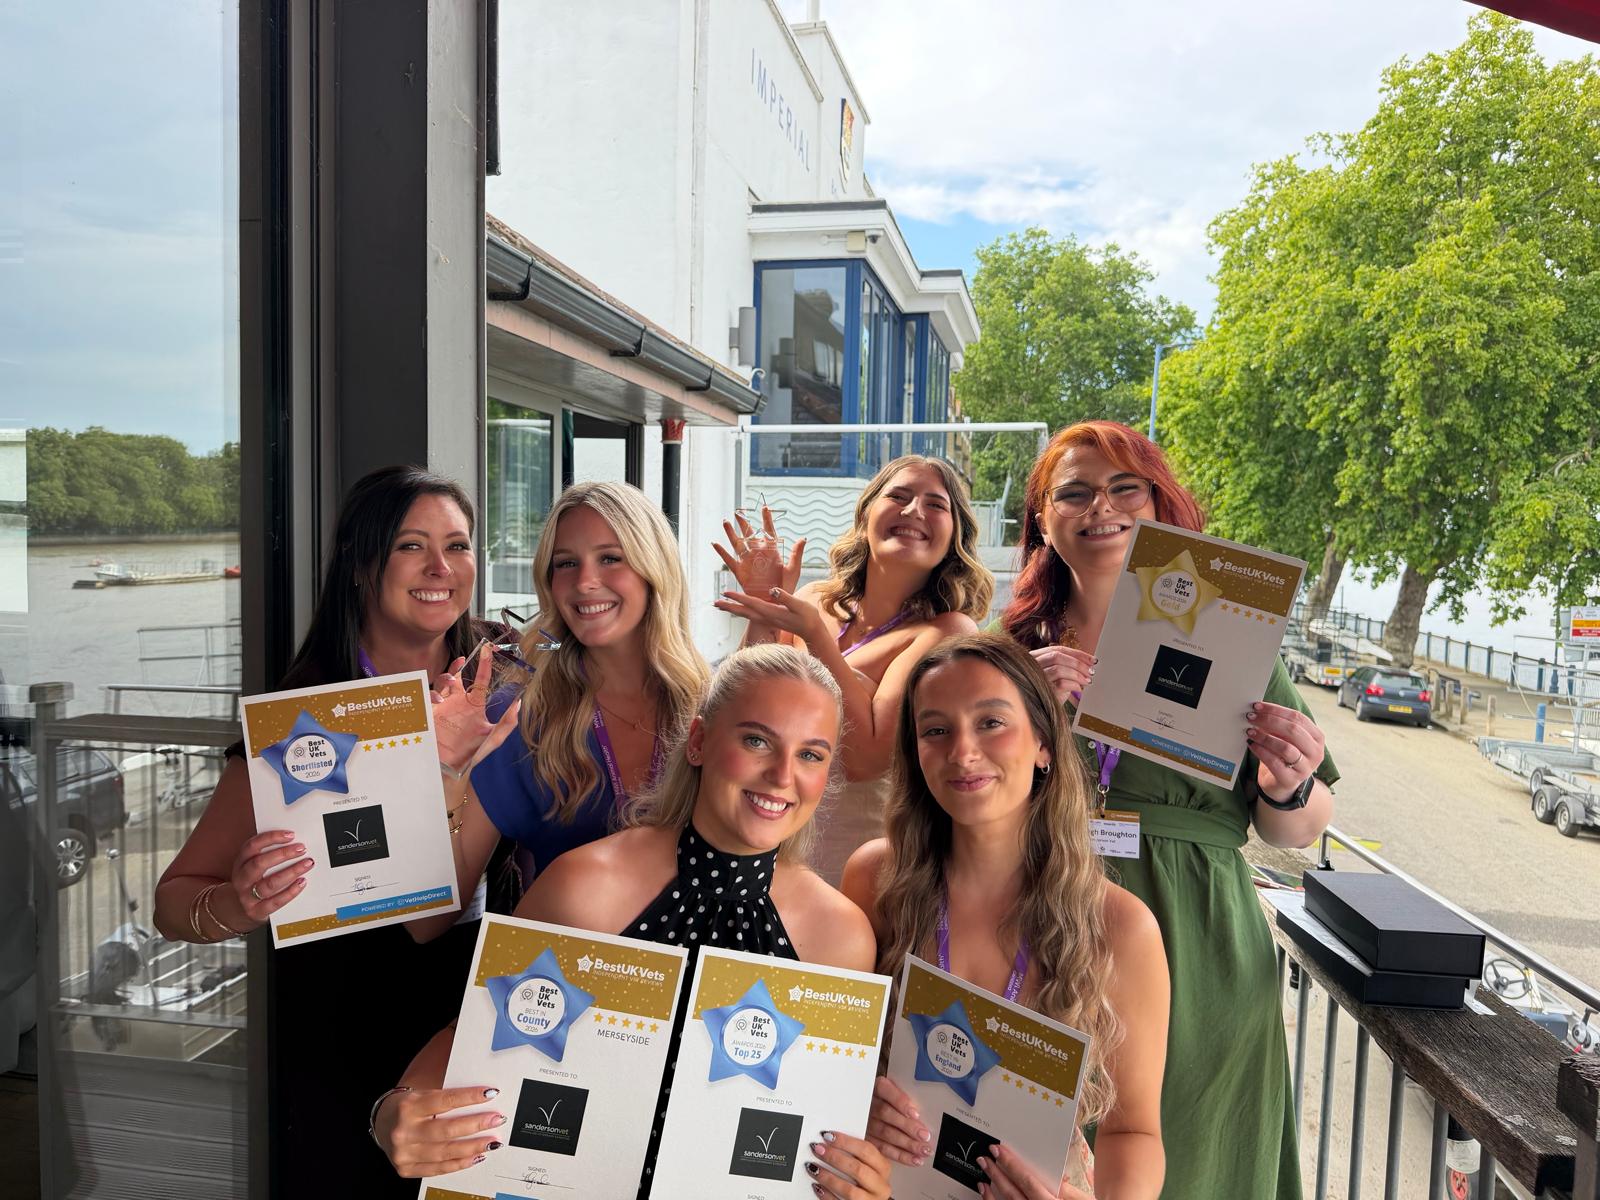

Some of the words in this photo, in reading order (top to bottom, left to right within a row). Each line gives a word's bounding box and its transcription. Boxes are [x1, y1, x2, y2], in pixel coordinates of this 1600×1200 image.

[751, 47, 810, 172] IMPERIAL
[1223, 561, 1286, 585] BestUKVets
[1177, 578, 1193, 586] Best
[1175, 588, 1190, 597] Vets
[347, 695, 412, 712] BestUKVets
[291, 760, 333, 772] Shortlisted
[1190, 752, 1229, 771] VetHelpDirect
[1100, 829, 1137, 839] Broughton
[337, 839, 377, 851] sandersonvet
[361, 903, 387, 912] POWERED
[404, 891, 446, 904] VetHelpDirect
[593, 957, 665, 981] BestUKVets
[540, 985, 558, 995] Best
[538, 993, 550, 1001] UK
[804, 987, 871, 1008] BestUKVets
[537, 1000, 555, 1009] Vets
[517, 1013, 551, 1029] County
[753, 1016, 771, 1024] Best
[597, 1029, 650, 1046] MERSEYSIDE
[751, 1029, 768, 1038] Vets
[952, 1032, 969, 1046] Best
[951, 1039, 962, 1049] UK
[1000, 1022, 1069, 1061] BestUKVets
[734, 1047, 749, 1059] Top
[751, 1050, 762, 1059] 25
[950, 1046, 966, 1058] Vets
[935, 1054, 962, 1072] England
[539, 1067, 569, 1078] PRESENTED
[756, 1096, 785, 1105] PRESENTED
[525, 1122, 569, 1135] sandersonvet
[743, 1150, 787, 1161] sandersonvet
